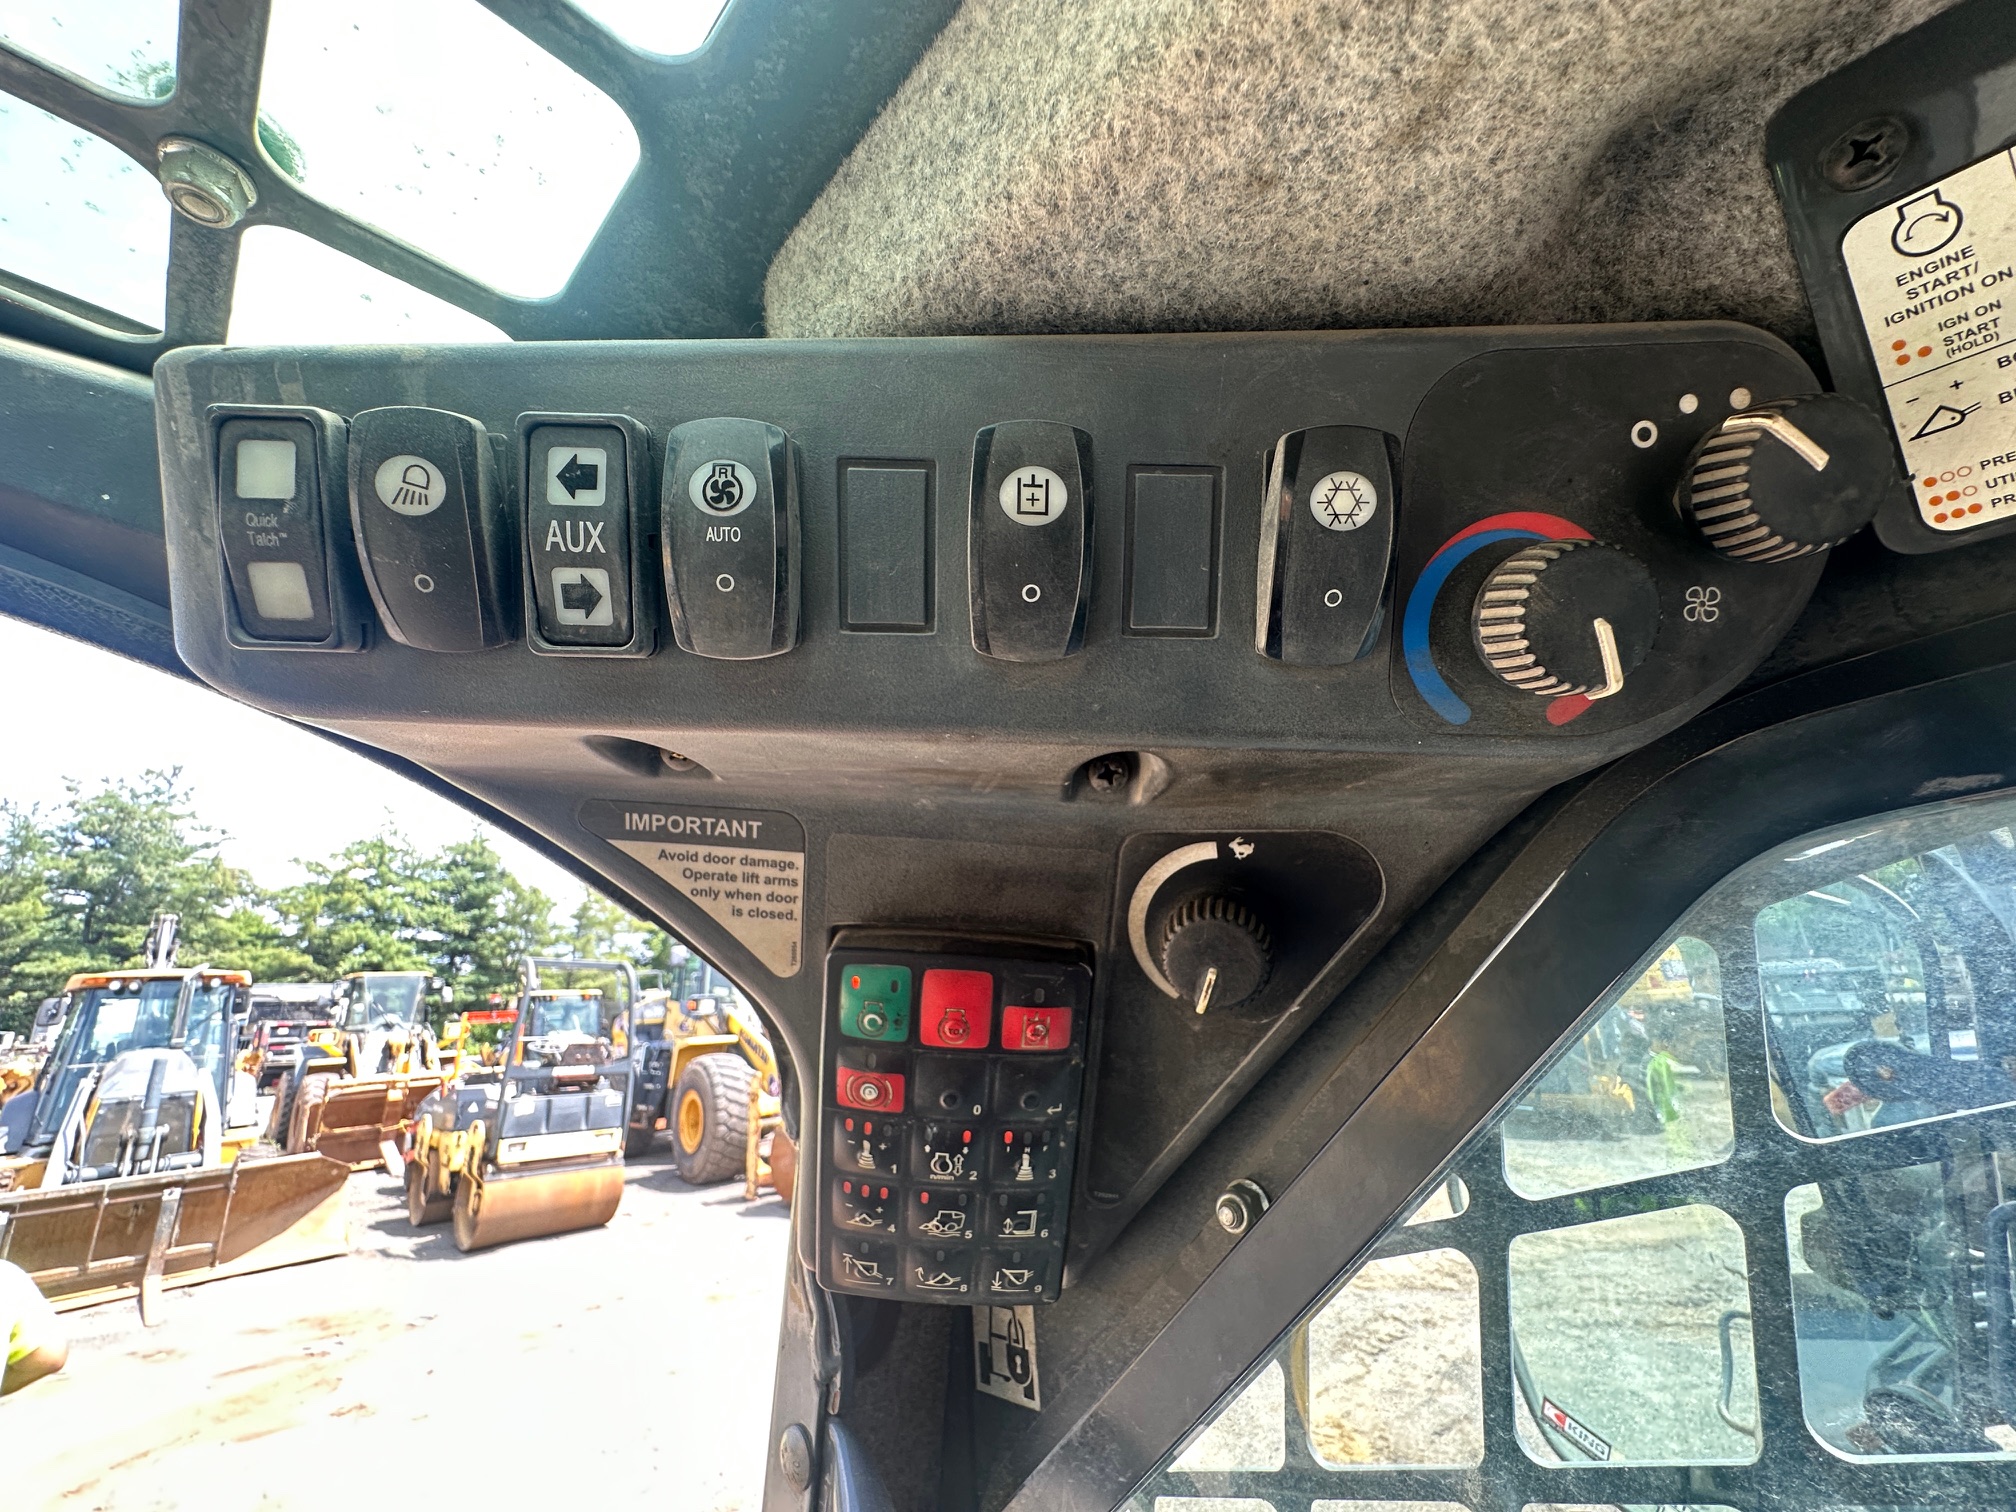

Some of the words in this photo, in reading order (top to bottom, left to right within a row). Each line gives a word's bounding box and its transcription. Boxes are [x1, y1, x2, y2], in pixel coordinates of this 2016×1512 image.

[1895, 245, 1976, 288] ENGINE
[1906, 261, 1979, 300] START/
[1884, 282, 1976, 328] IGNITION
[1980, 266, 2014, 288] ON
[1937, 311, 1970, 332] IGN
[1974, 299, 2003, 317] ON
[1942, 317, 2001, 347] START
[1946, 331, 2000, 359] (HOLD)
[1997, 351, 2016, 369] B
[1998, 388, 2016, 405] B
[1985, 471, 2016, 489] UTI
[246, 512, 279, 528] Quick
[546, 519, 606, 554] AUX
[706, 526, 741, 543] AUTO
[625, 812, 762, 839] IMPORTANT
[658, 849, 699, 863] Avoid
[703, 851, 736, 866] door
[739, 854, 799, 872] damage.
[682, 868, 737, 883] Operate
[742, 870, 760, 885] lift
[763, 875, 799, 888] arms
[690, 886, 721, 902] only
[724, 889, 762, 903] when
[765, 890, 799, 904] door
[731, 905, 743, 918] is
[748, 905, 798, 922] closed.
[973, 1104, 982, 1115] 0
[890, 1164, 898, 1175] 1
[969, 1170, 978, 1180] 2
[1049, 1168, 1057, 1179] 3
[887, 1223, 896, 1233] 4
[964, 1230, 973, 1239] 5
[1040, 1229, 1049, 1238] 6
[886, 1277, 895, 1286] 7
[959, 1283, 968, 1293] 8
[1033, 1284, 1043, 1293] 9
